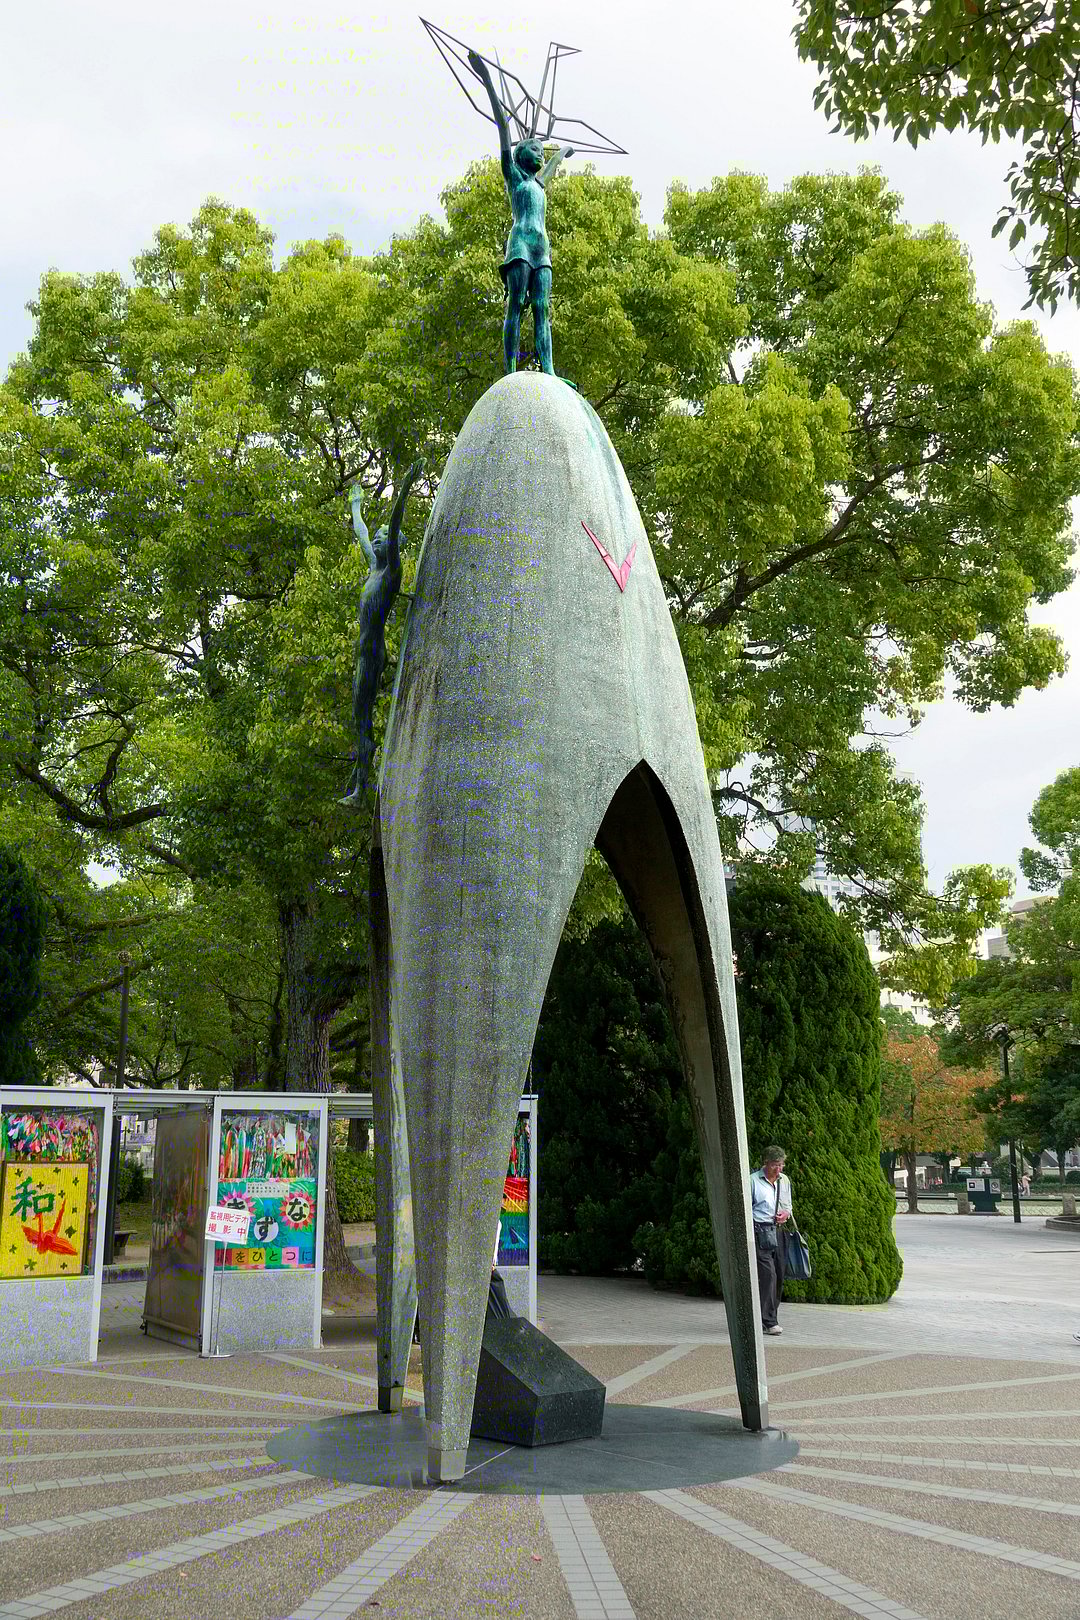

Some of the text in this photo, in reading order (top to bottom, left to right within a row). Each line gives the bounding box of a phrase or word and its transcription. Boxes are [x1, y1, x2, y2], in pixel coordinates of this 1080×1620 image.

[10, 1176, 55, 1222] 和
[210, 1211, 248, 1224] 監視用ビデオ
